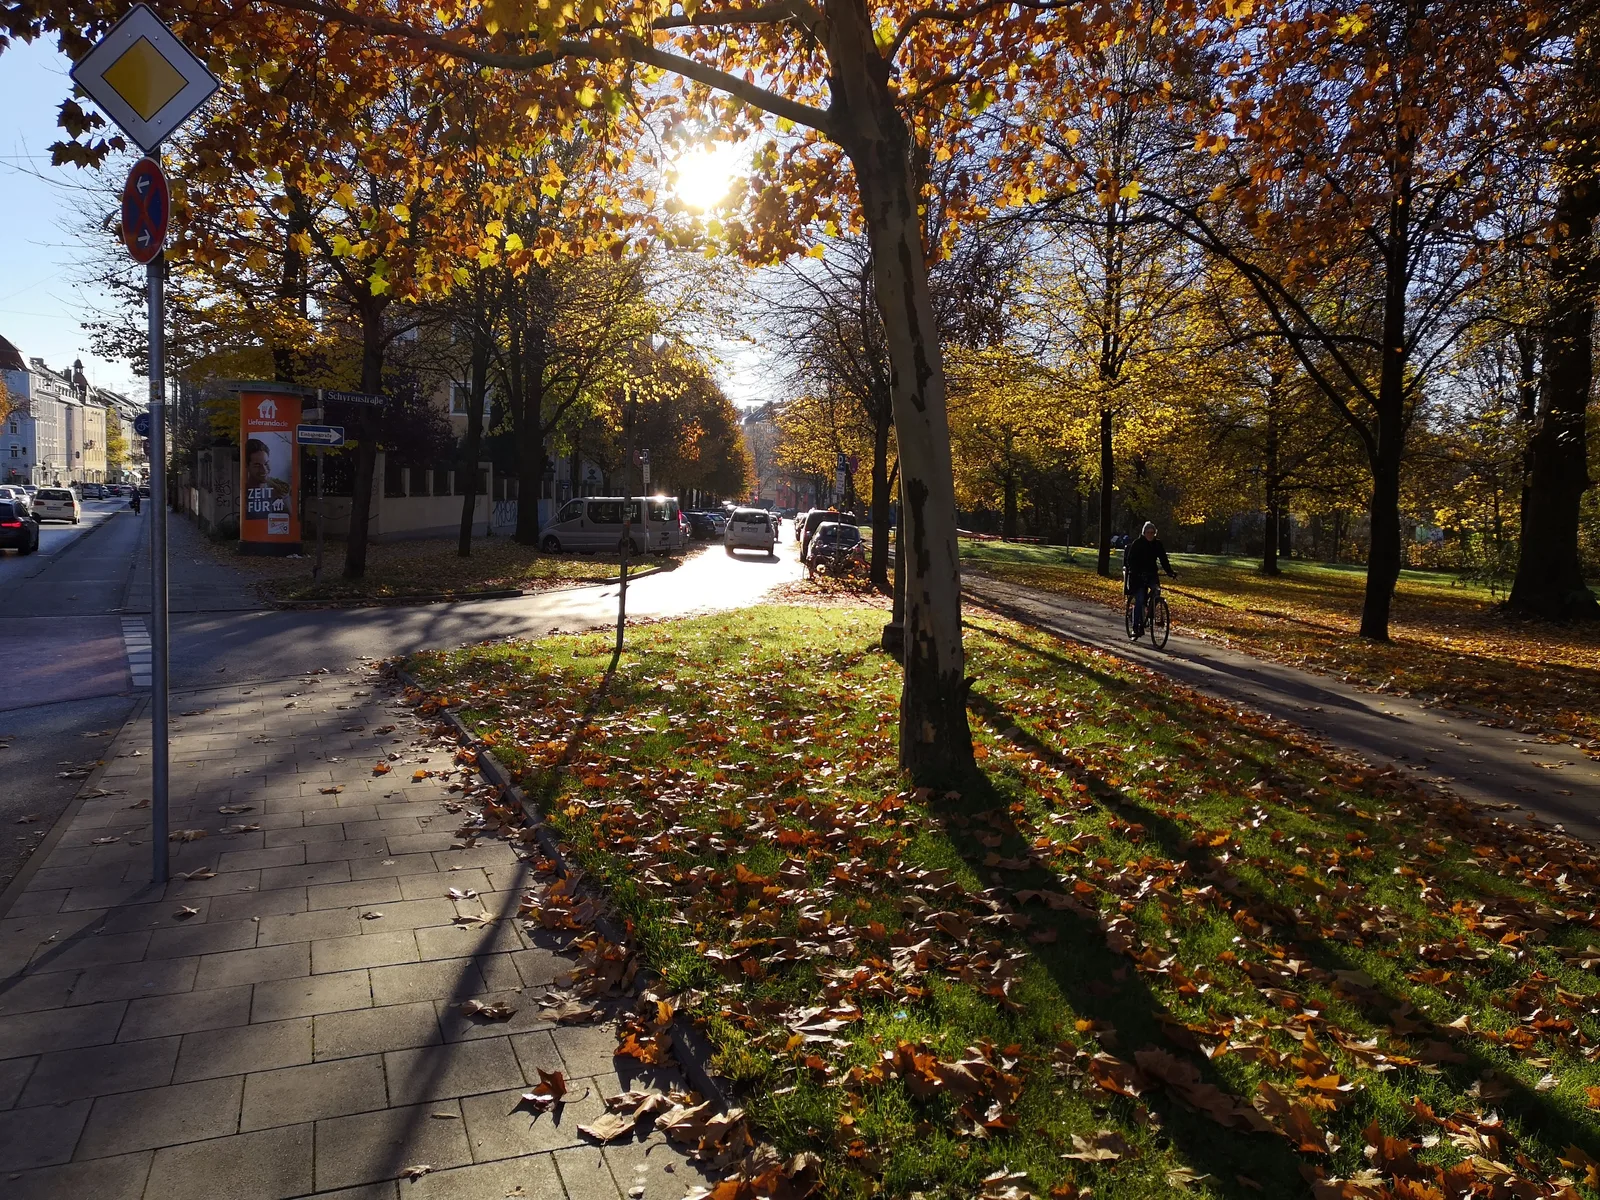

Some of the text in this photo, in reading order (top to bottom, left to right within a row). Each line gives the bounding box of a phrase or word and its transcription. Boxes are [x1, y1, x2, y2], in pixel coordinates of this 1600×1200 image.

[327, 391, 384, 406] Schyrenstraße
[247, 487, 274, 499] ZEIT
[247, 498, 270, 512] FÜR
